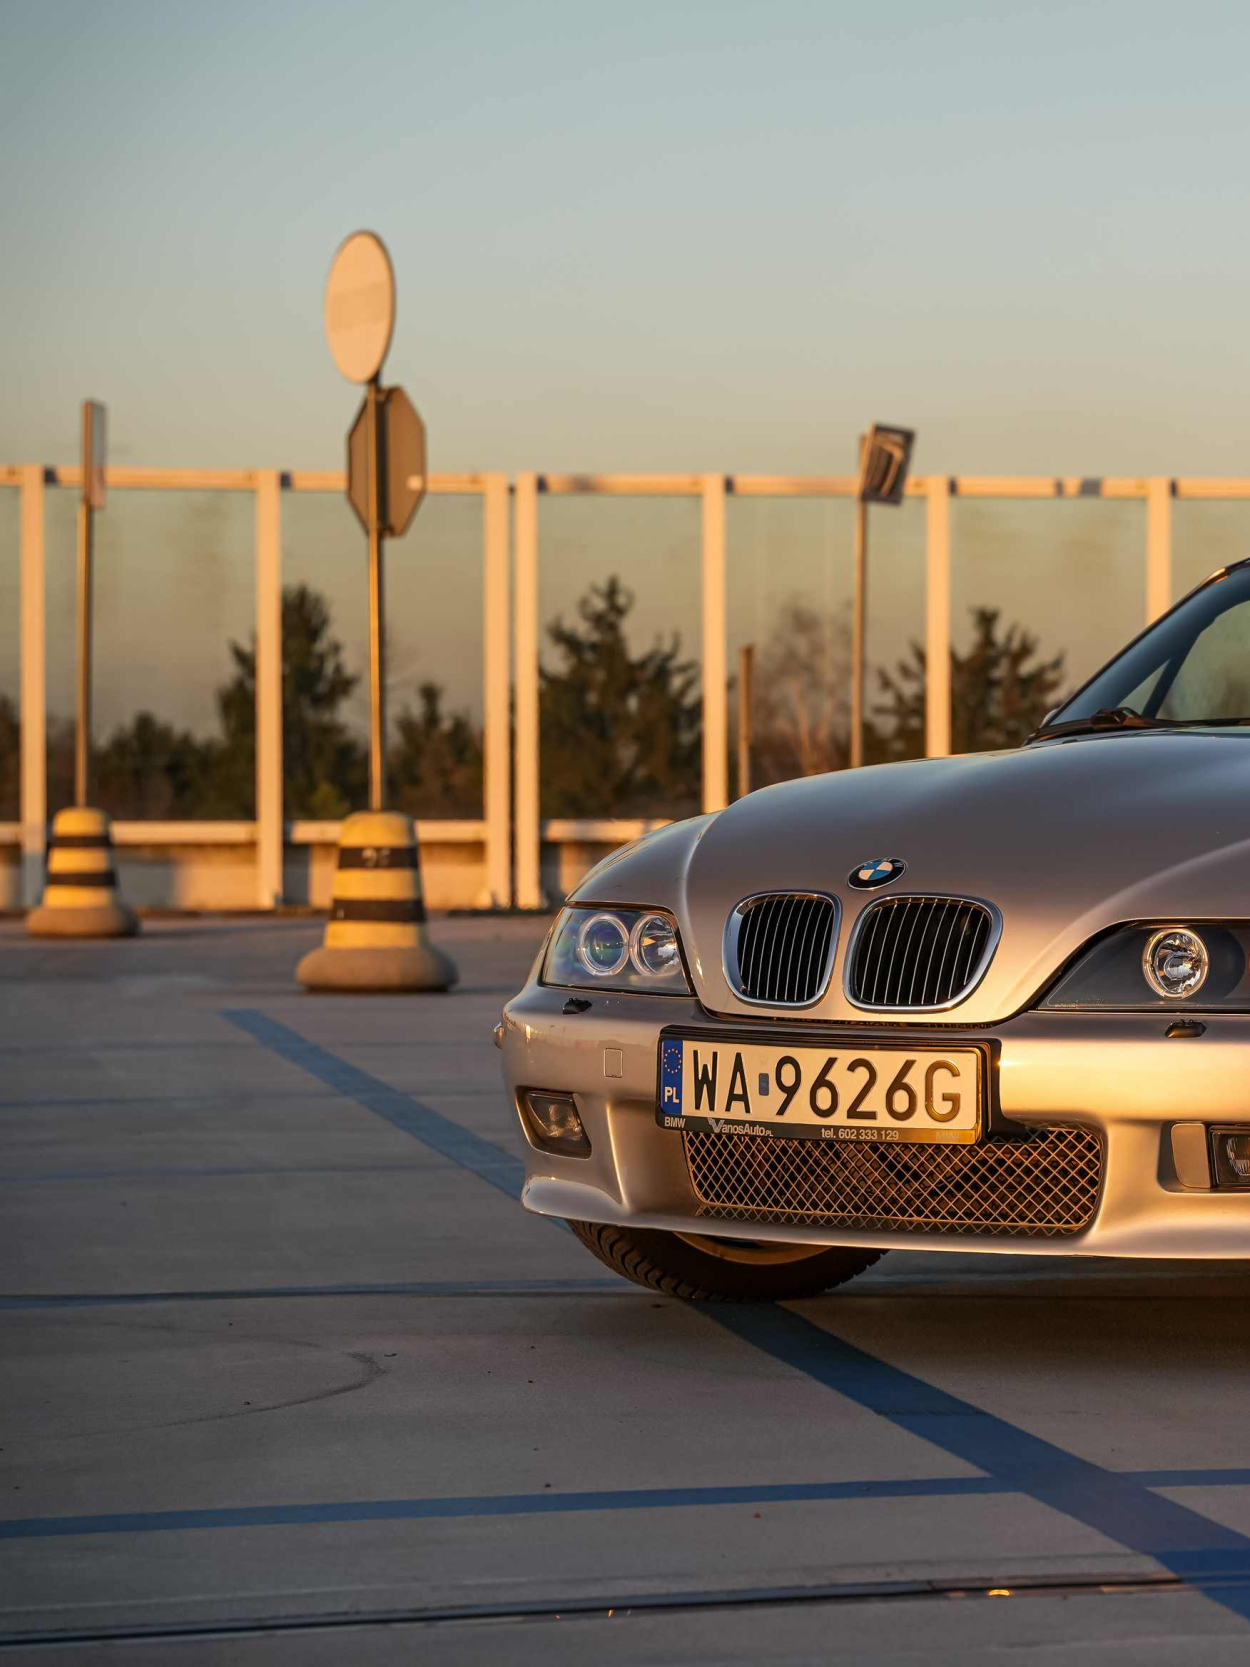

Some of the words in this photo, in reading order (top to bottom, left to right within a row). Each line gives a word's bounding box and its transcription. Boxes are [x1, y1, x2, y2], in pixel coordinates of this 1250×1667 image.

[693, 1049, 751, 1114] WA
[775, 1055, 962, 1123] 9626G
[664, 1086, 679, 1104] PL
[664, 1116, 686, 1129] BMW
[821, 1128, 836, 1139] tel.
[838, 1128, 857, 1140] 602
[859, 1129, 878, 1140] 333
[881, 1130, 899, 1141] 129
